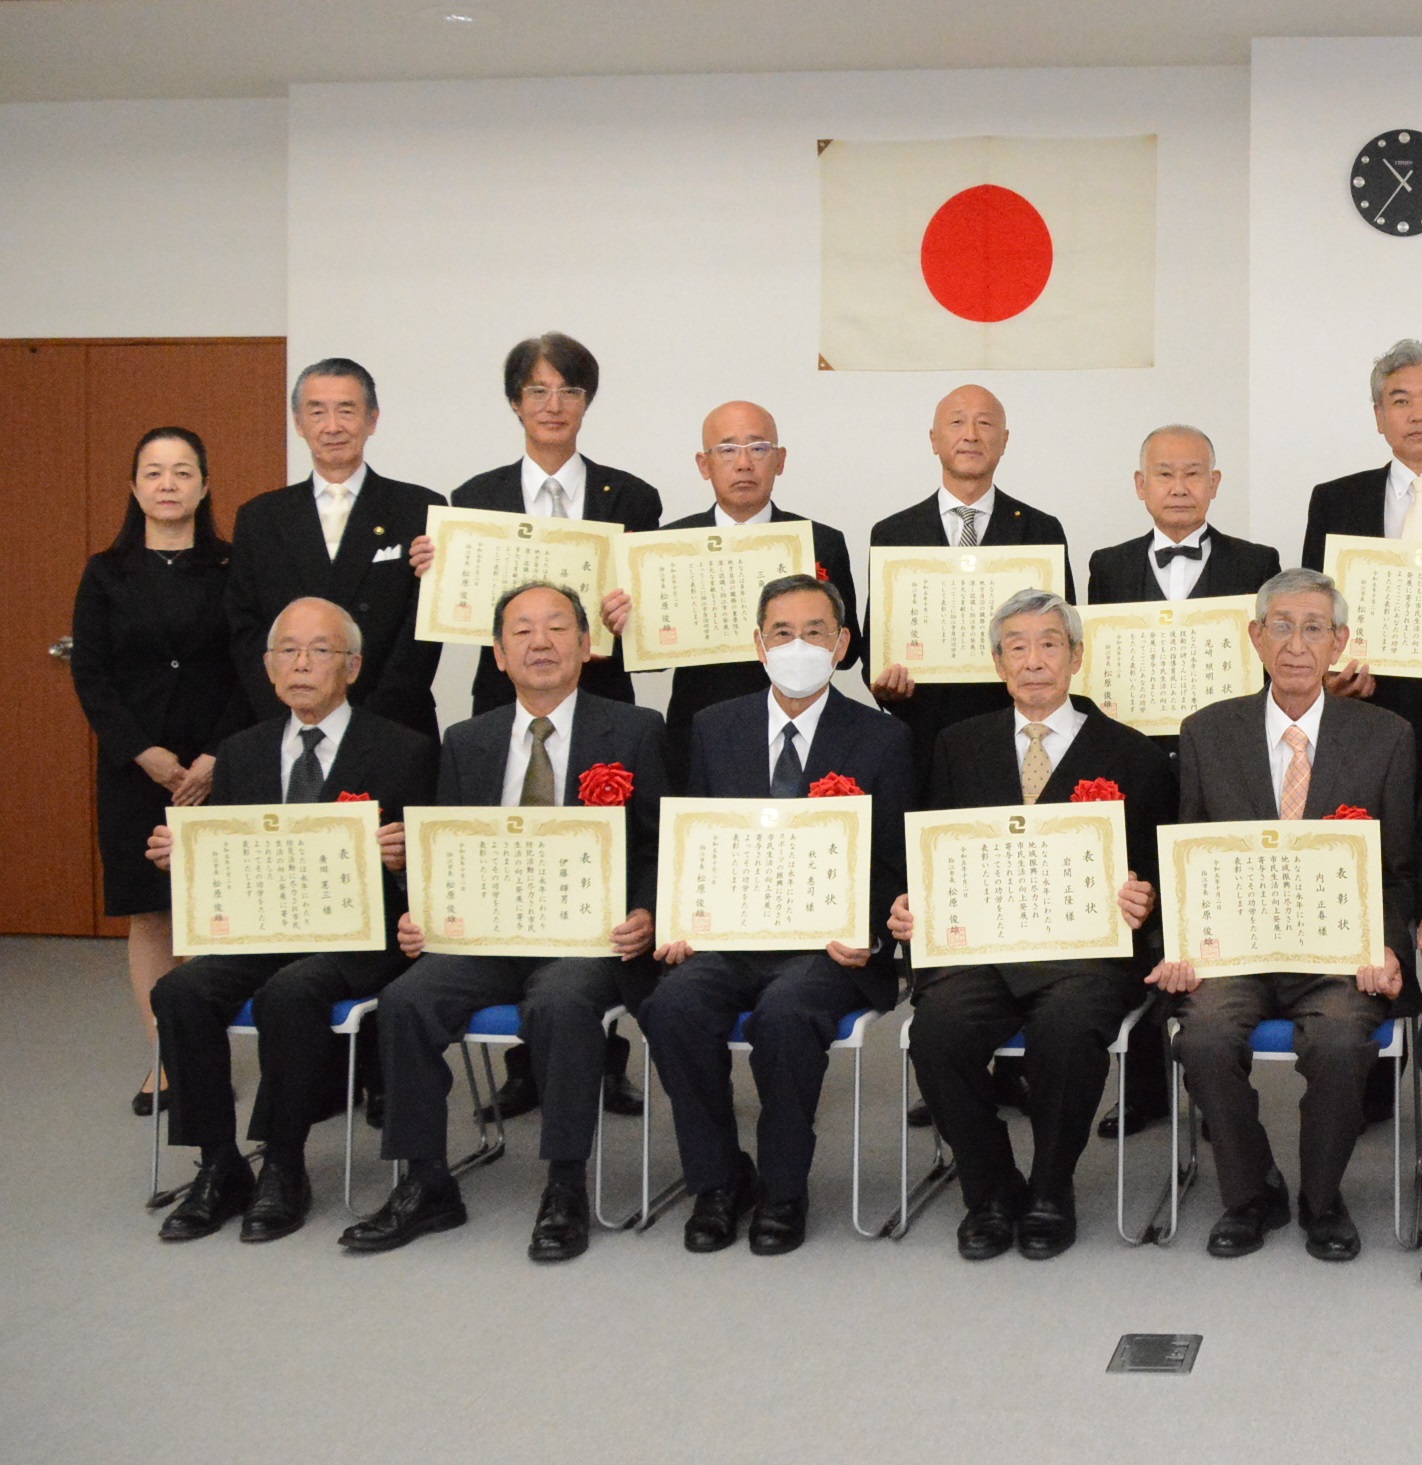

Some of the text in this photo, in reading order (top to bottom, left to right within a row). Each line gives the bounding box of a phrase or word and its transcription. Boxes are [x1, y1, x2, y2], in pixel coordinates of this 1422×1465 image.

[1222, 638, 1233, 694] 表彰状
[339, 848, 354, 908] 表彰状
[579, 852, 592, 914] 表彰状
[825, 843, 839, 905] 表彰状
[1064, 857, 1075, 921] 岩間 正隆 様
[1083, 850, 1098, 914] 表彰状
[1316, 873, 1327, 936] 内山 正春 様
[1336, 867, 1350, 931] 表彰状
